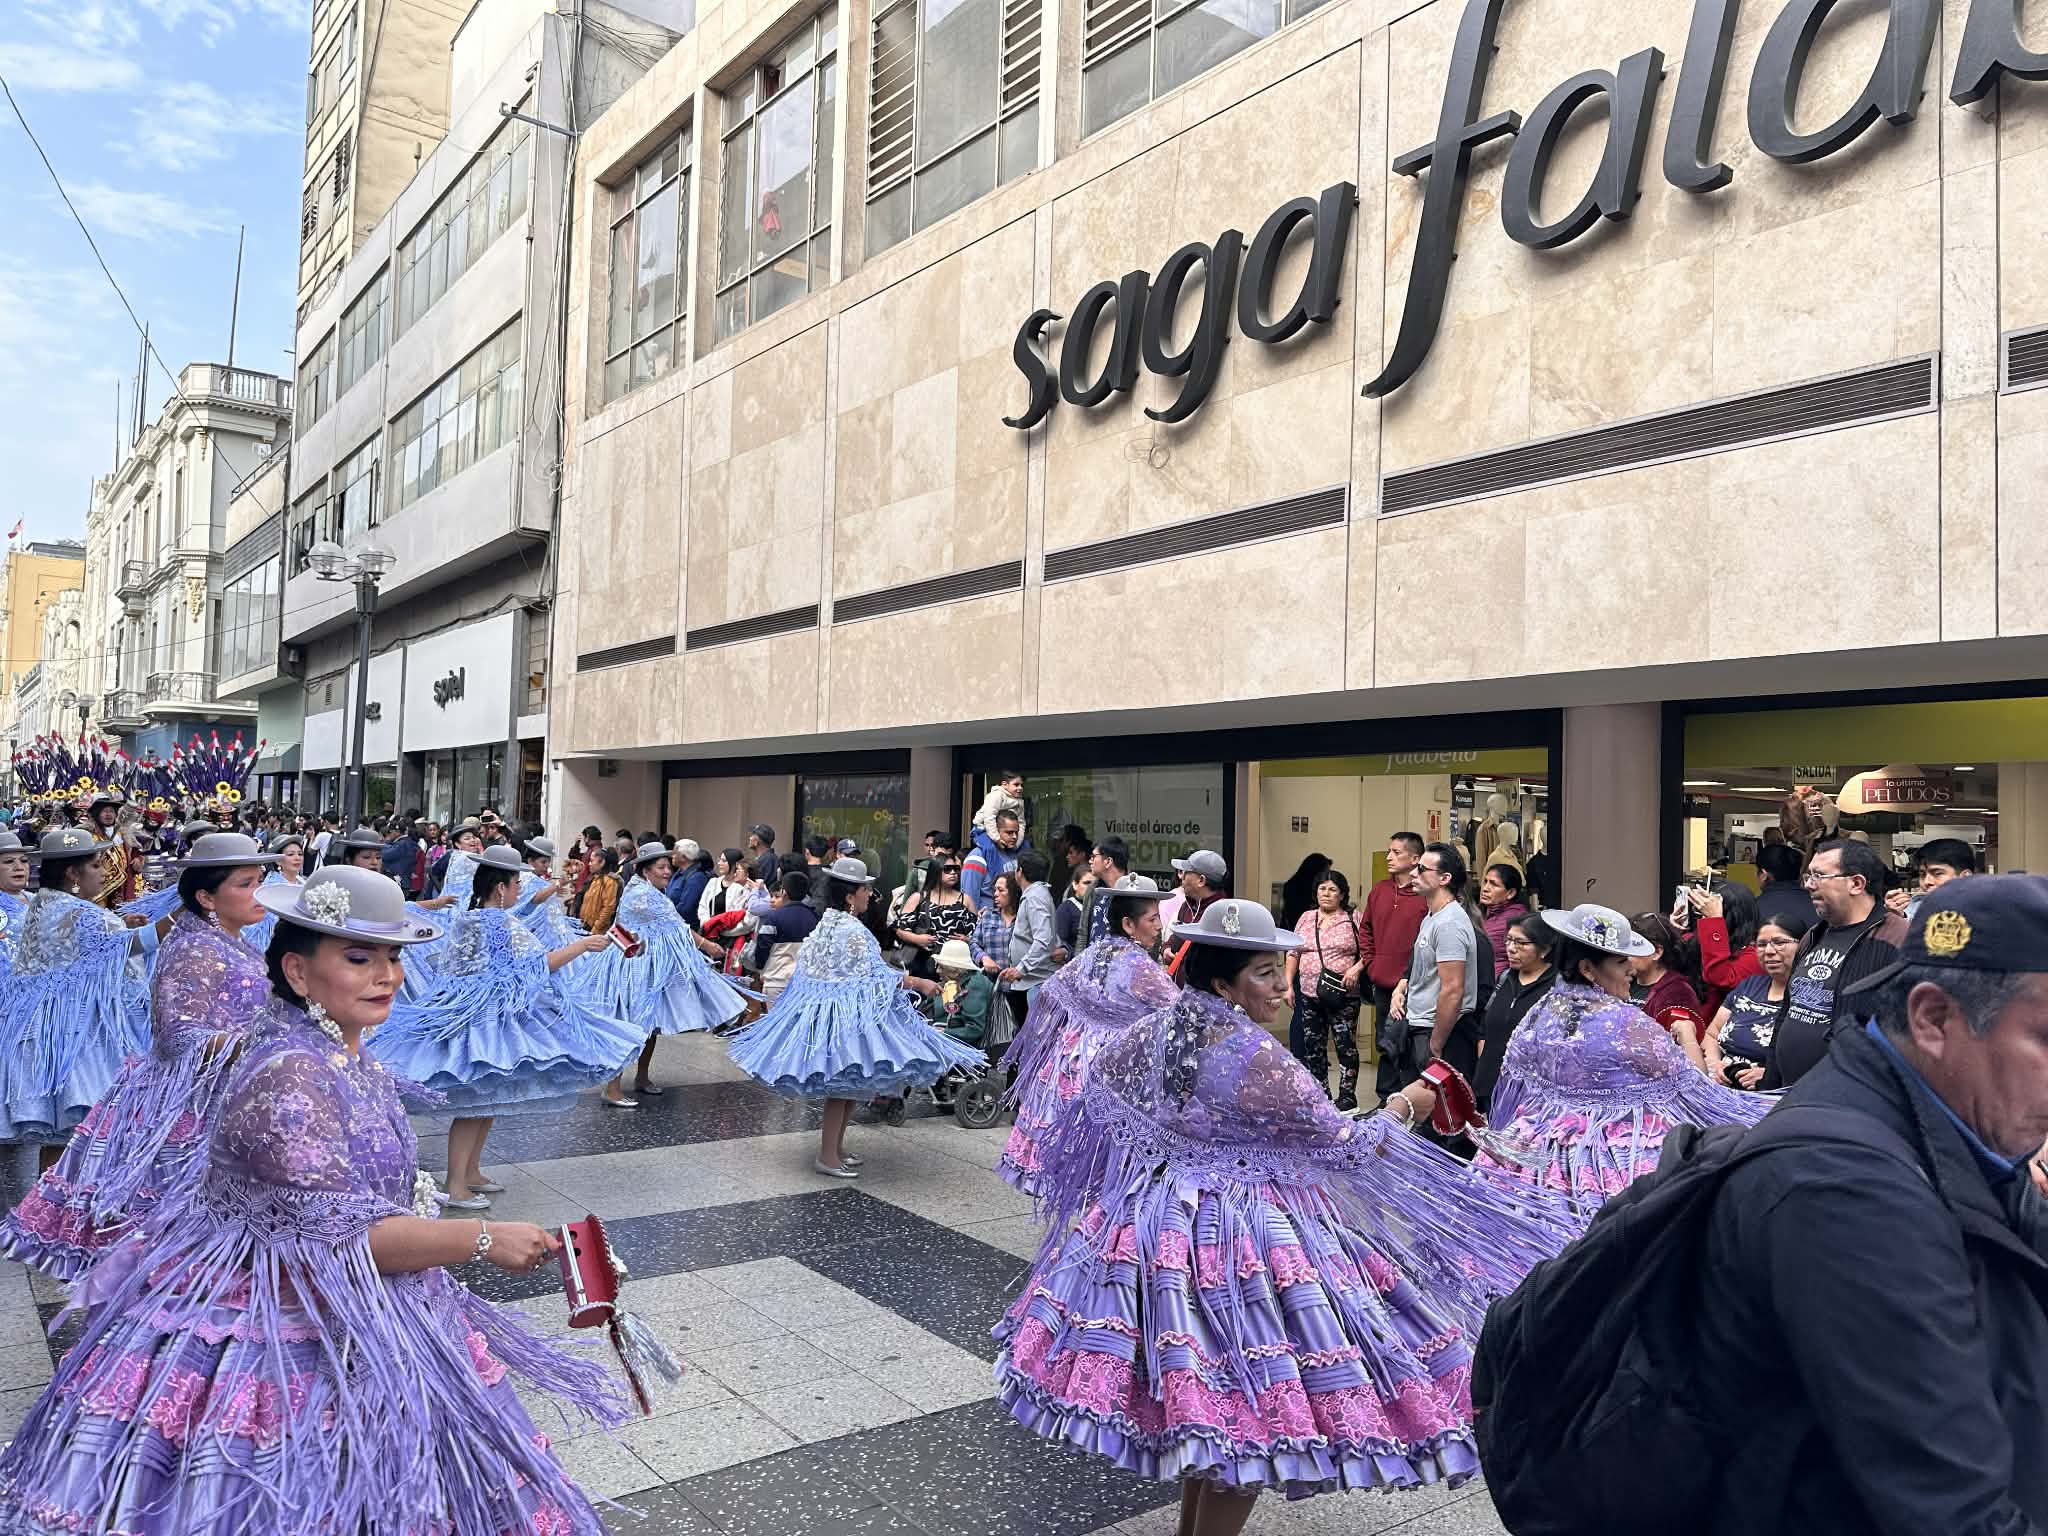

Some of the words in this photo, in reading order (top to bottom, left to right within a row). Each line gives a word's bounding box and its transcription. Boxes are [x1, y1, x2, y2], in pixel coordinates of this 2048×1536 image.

[1002, 181, 1357, 429] saga
[1796, 765, 1832, 779] SALIDA
[1865, 787, 1950, 802] PELUDOS
[1105, 820, 1138, 833] Visite
[1139, 820, 1151, 833] el
[1152, 820, 1181, 834] área
[1183, 820, 1201, 834] de
[1128, 840, 1200, 864] ECTRO
[1804, 948, 1846, 969] TOMM
